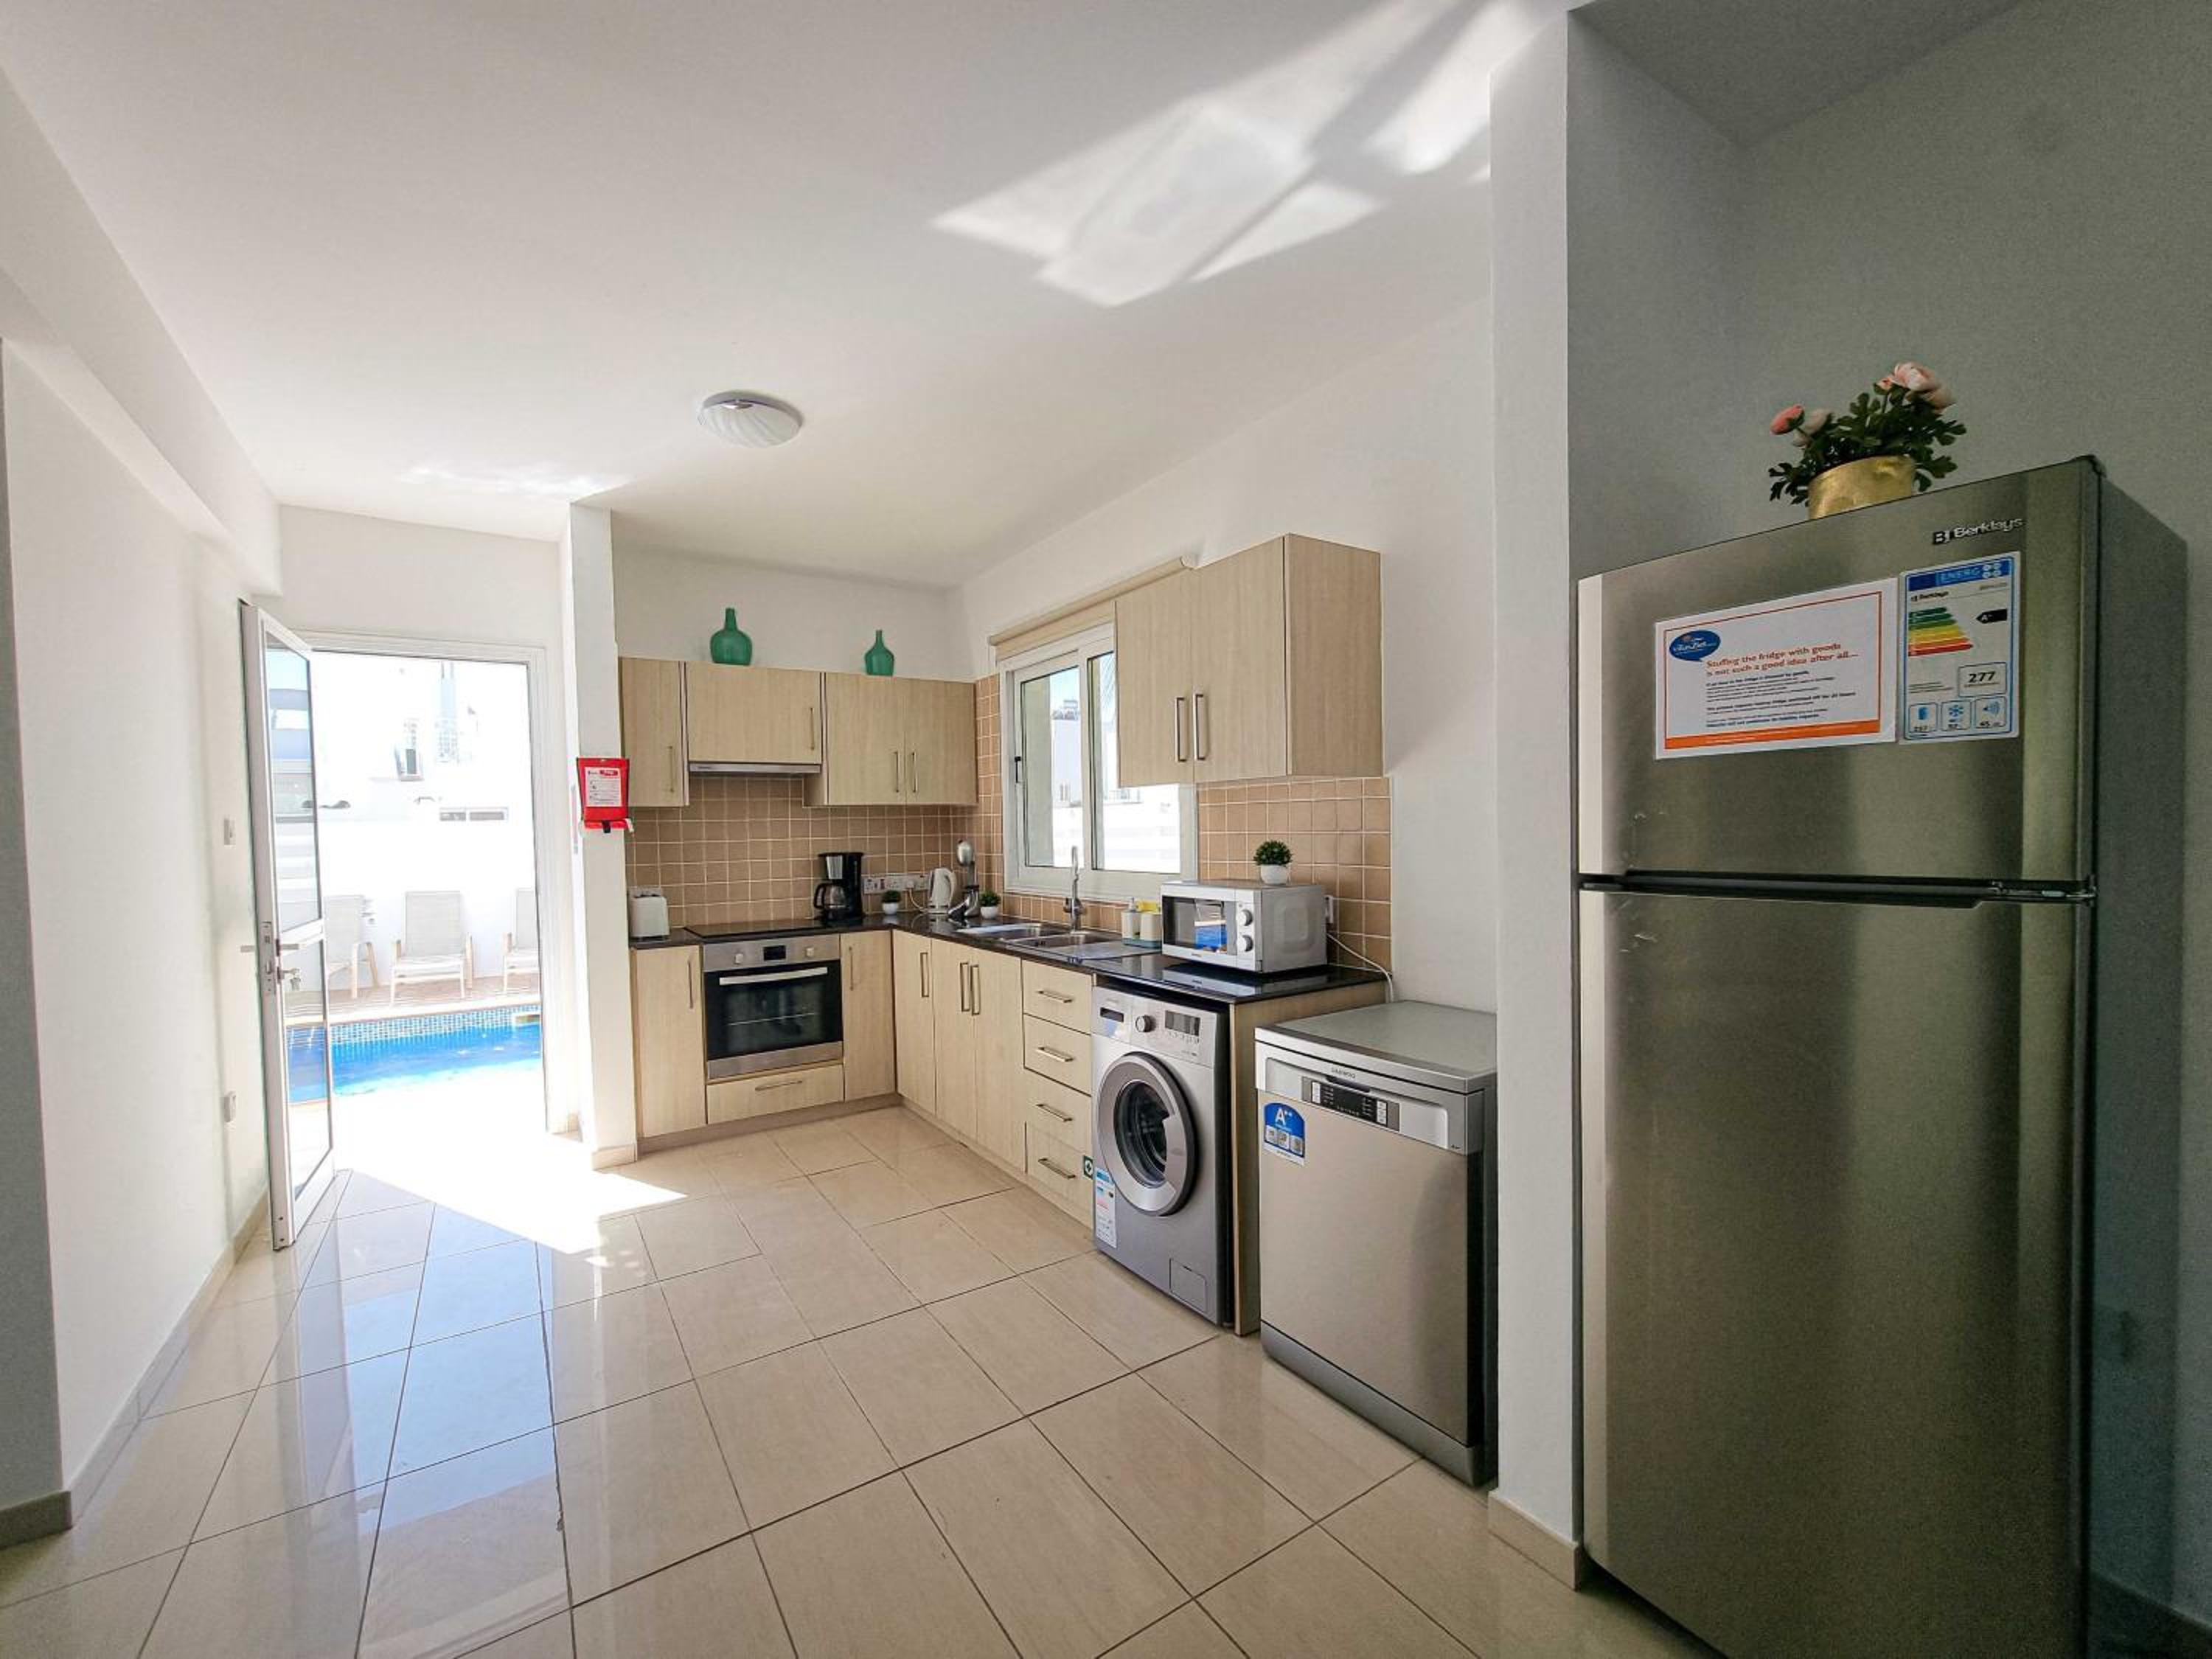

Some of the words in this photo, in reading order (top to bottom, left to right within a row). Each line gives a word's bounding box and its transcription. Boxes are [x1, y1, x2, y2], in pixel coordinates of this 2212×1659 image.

[1742, 655, 1757, 663] the
[1759, 650, 1785, 661] fridge
[1788, 647, 1809, 656] with
[1761, 658, 1785, 671] good
[1810, 653, 1835, 663] after
[1968, 670, 1996, 684] 277
